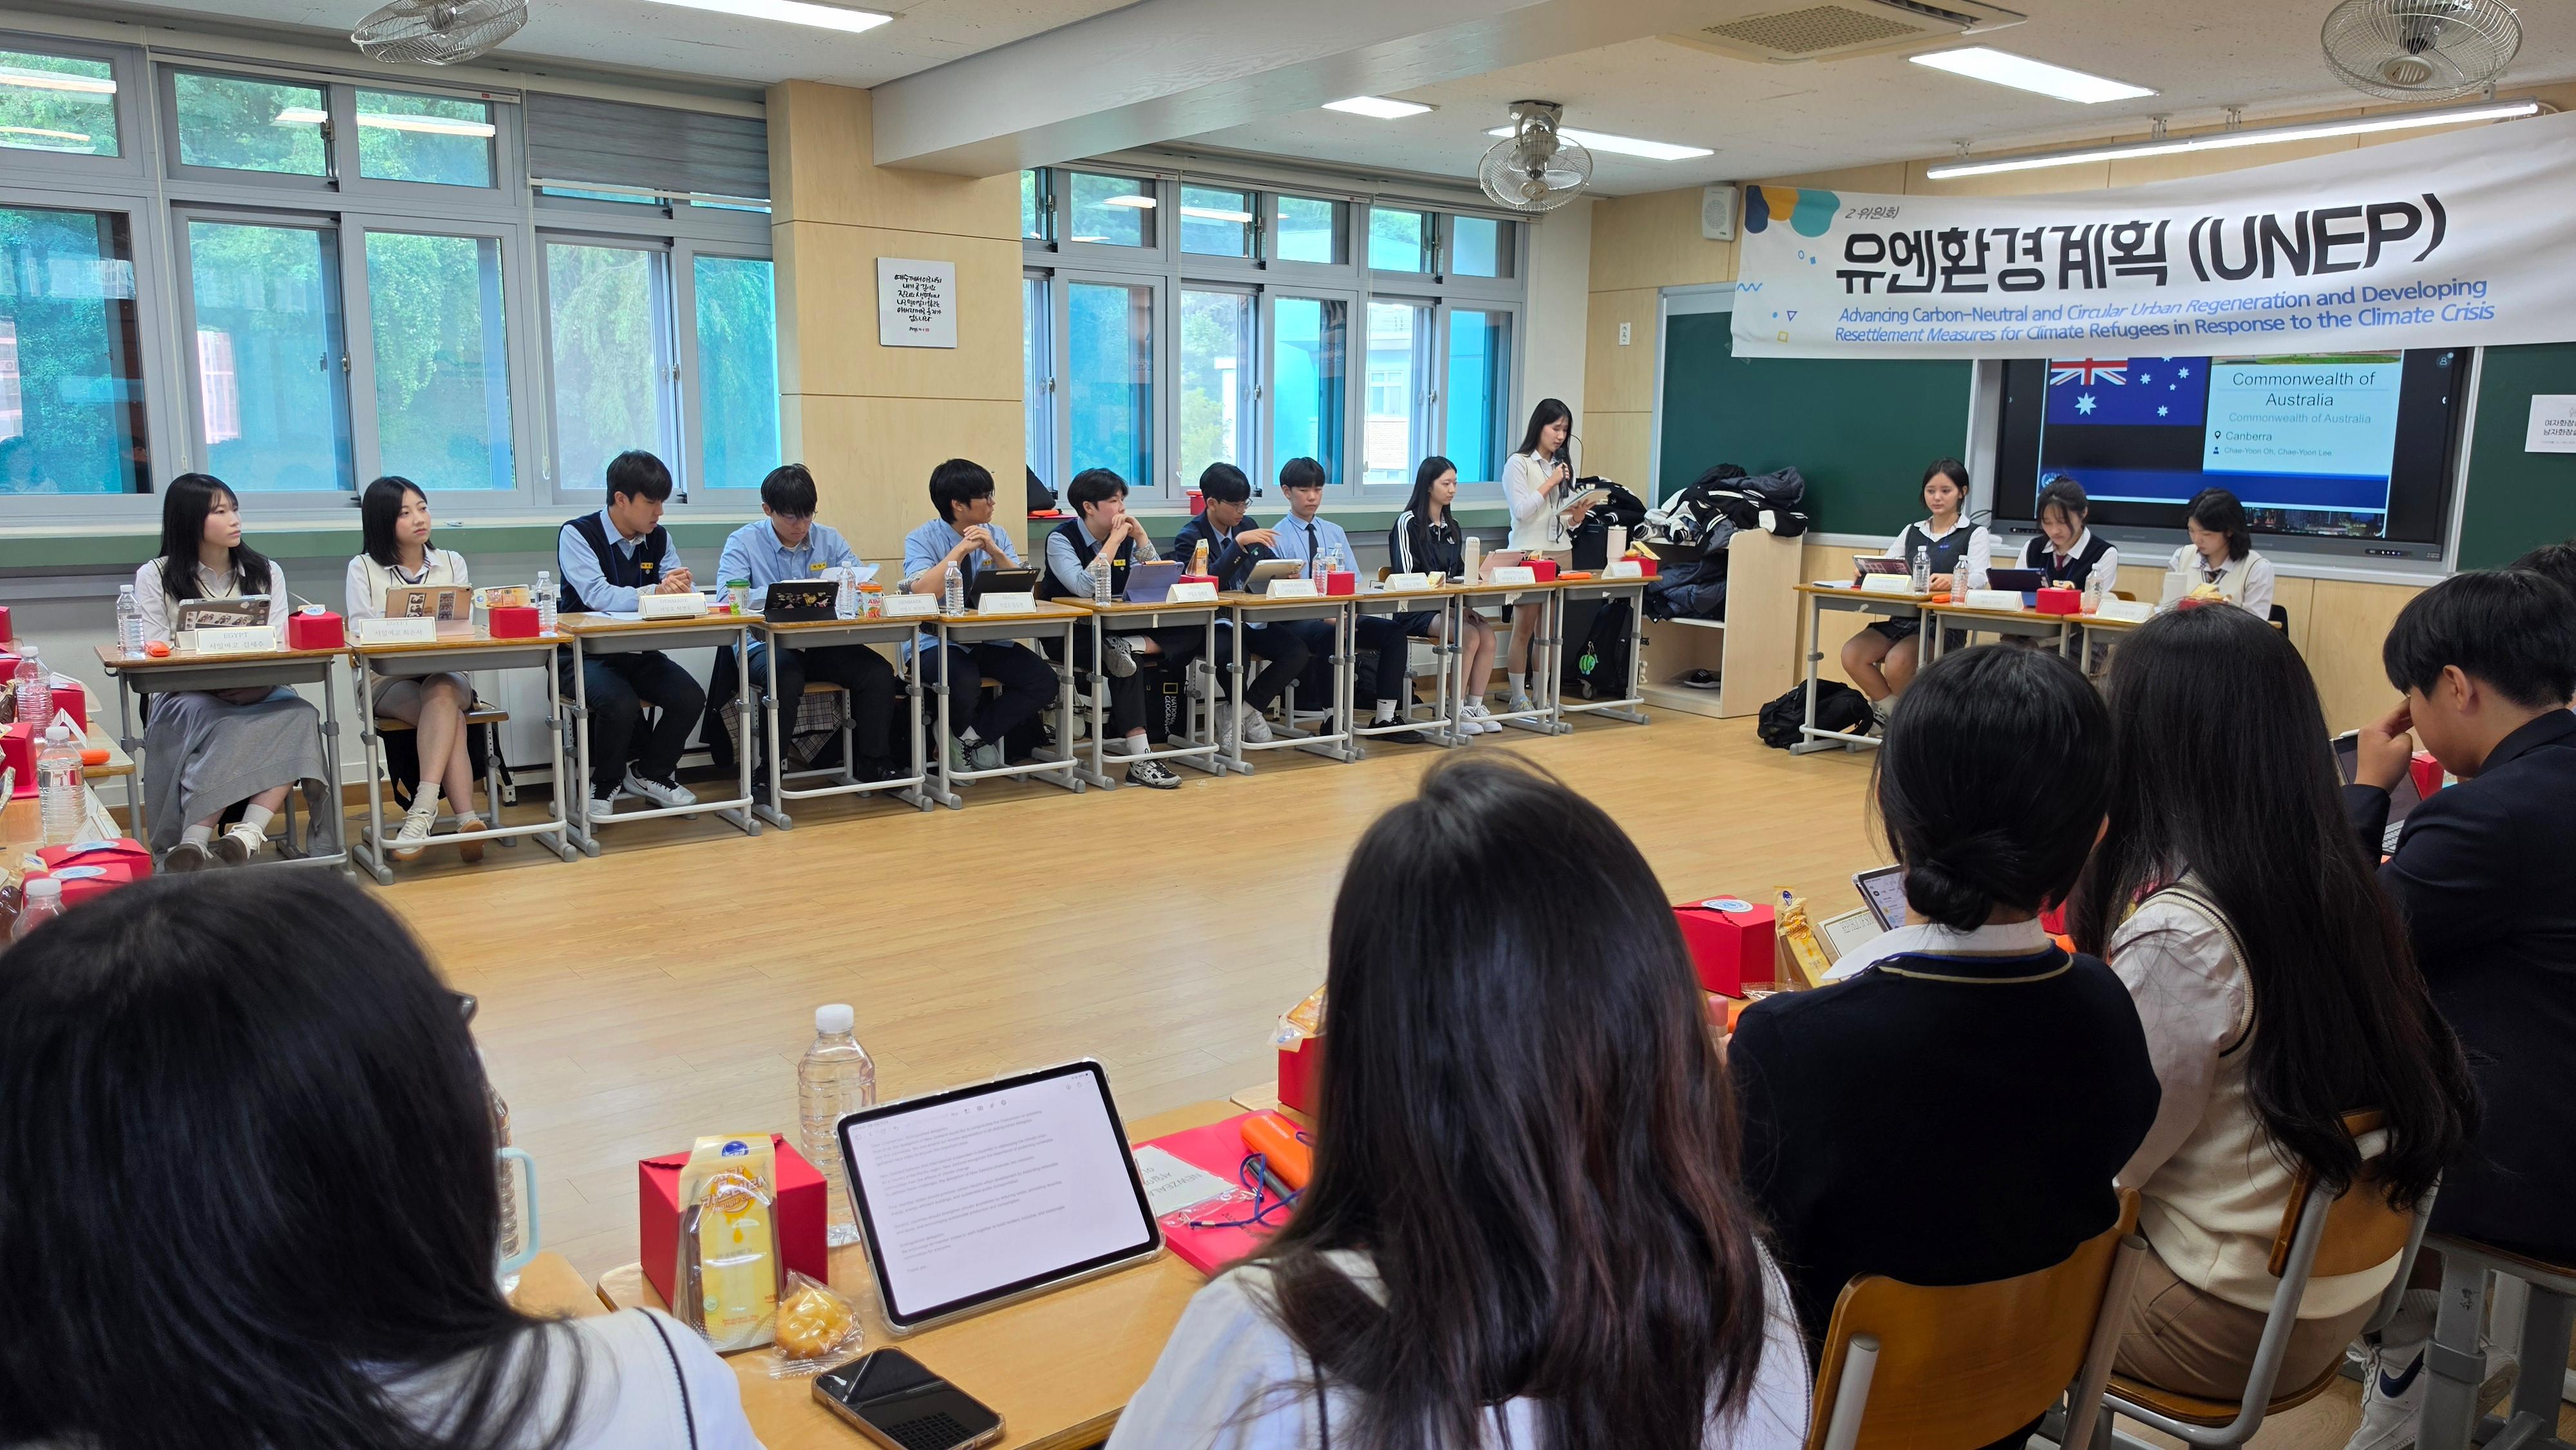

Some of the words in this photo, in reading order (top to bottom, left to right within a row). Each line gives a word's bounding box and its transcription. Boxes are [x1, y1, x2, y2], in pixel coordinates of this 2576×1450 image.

[1845, 208, 1856, 220] 2
[1857, 205, 1900, 220] 위원회
[1836, 220, 2172, 294] 유엔환경계획
[2188, 193, 2447, 282] (UNEP)
[1839, 306, 1909, 325] Advancing
[2032, 304, 2062, 321] and
[2067, 303, 2128, 321] Circular
[2131, 301, 2184, 316] Urban
[2186, 291, 2311, 315] Regeneration
[2316, 286, 2356, 307] and
[2362, 278, 2488, 304] Developing
[1835, 326, 1924, 342] Resettlement
[1927, 327, 1996, 342] Measures
[2000, 326, 2023, 341] for
[2026, 324, 2084, 341] Climate
[2090, 321, 2170, 339] Refugees
[2174, 319, 2190, 335] in
[2195, 317, 2285, 335] Response
[2290, 314, 2312, 329] to
[2316, 308, 2352, 328] the
[2358, 305, 2435, 327] Climate
[2441, 301, 2496, 322] Crisis
[2232, 372, 2354, 386] Commonwealth
[2360, 372, 2376, 386] of
[2266, 393, 2333, 406] Australia
[2228, 412, 2308, 423] Commonwealth
[2311, 413, 2323, 423] of
[2324, 414, 2371, 424] Australia
[2226, 431, 2273, 441] Canberra
[2278, 448, 2316, 457] Chae-Yoon
